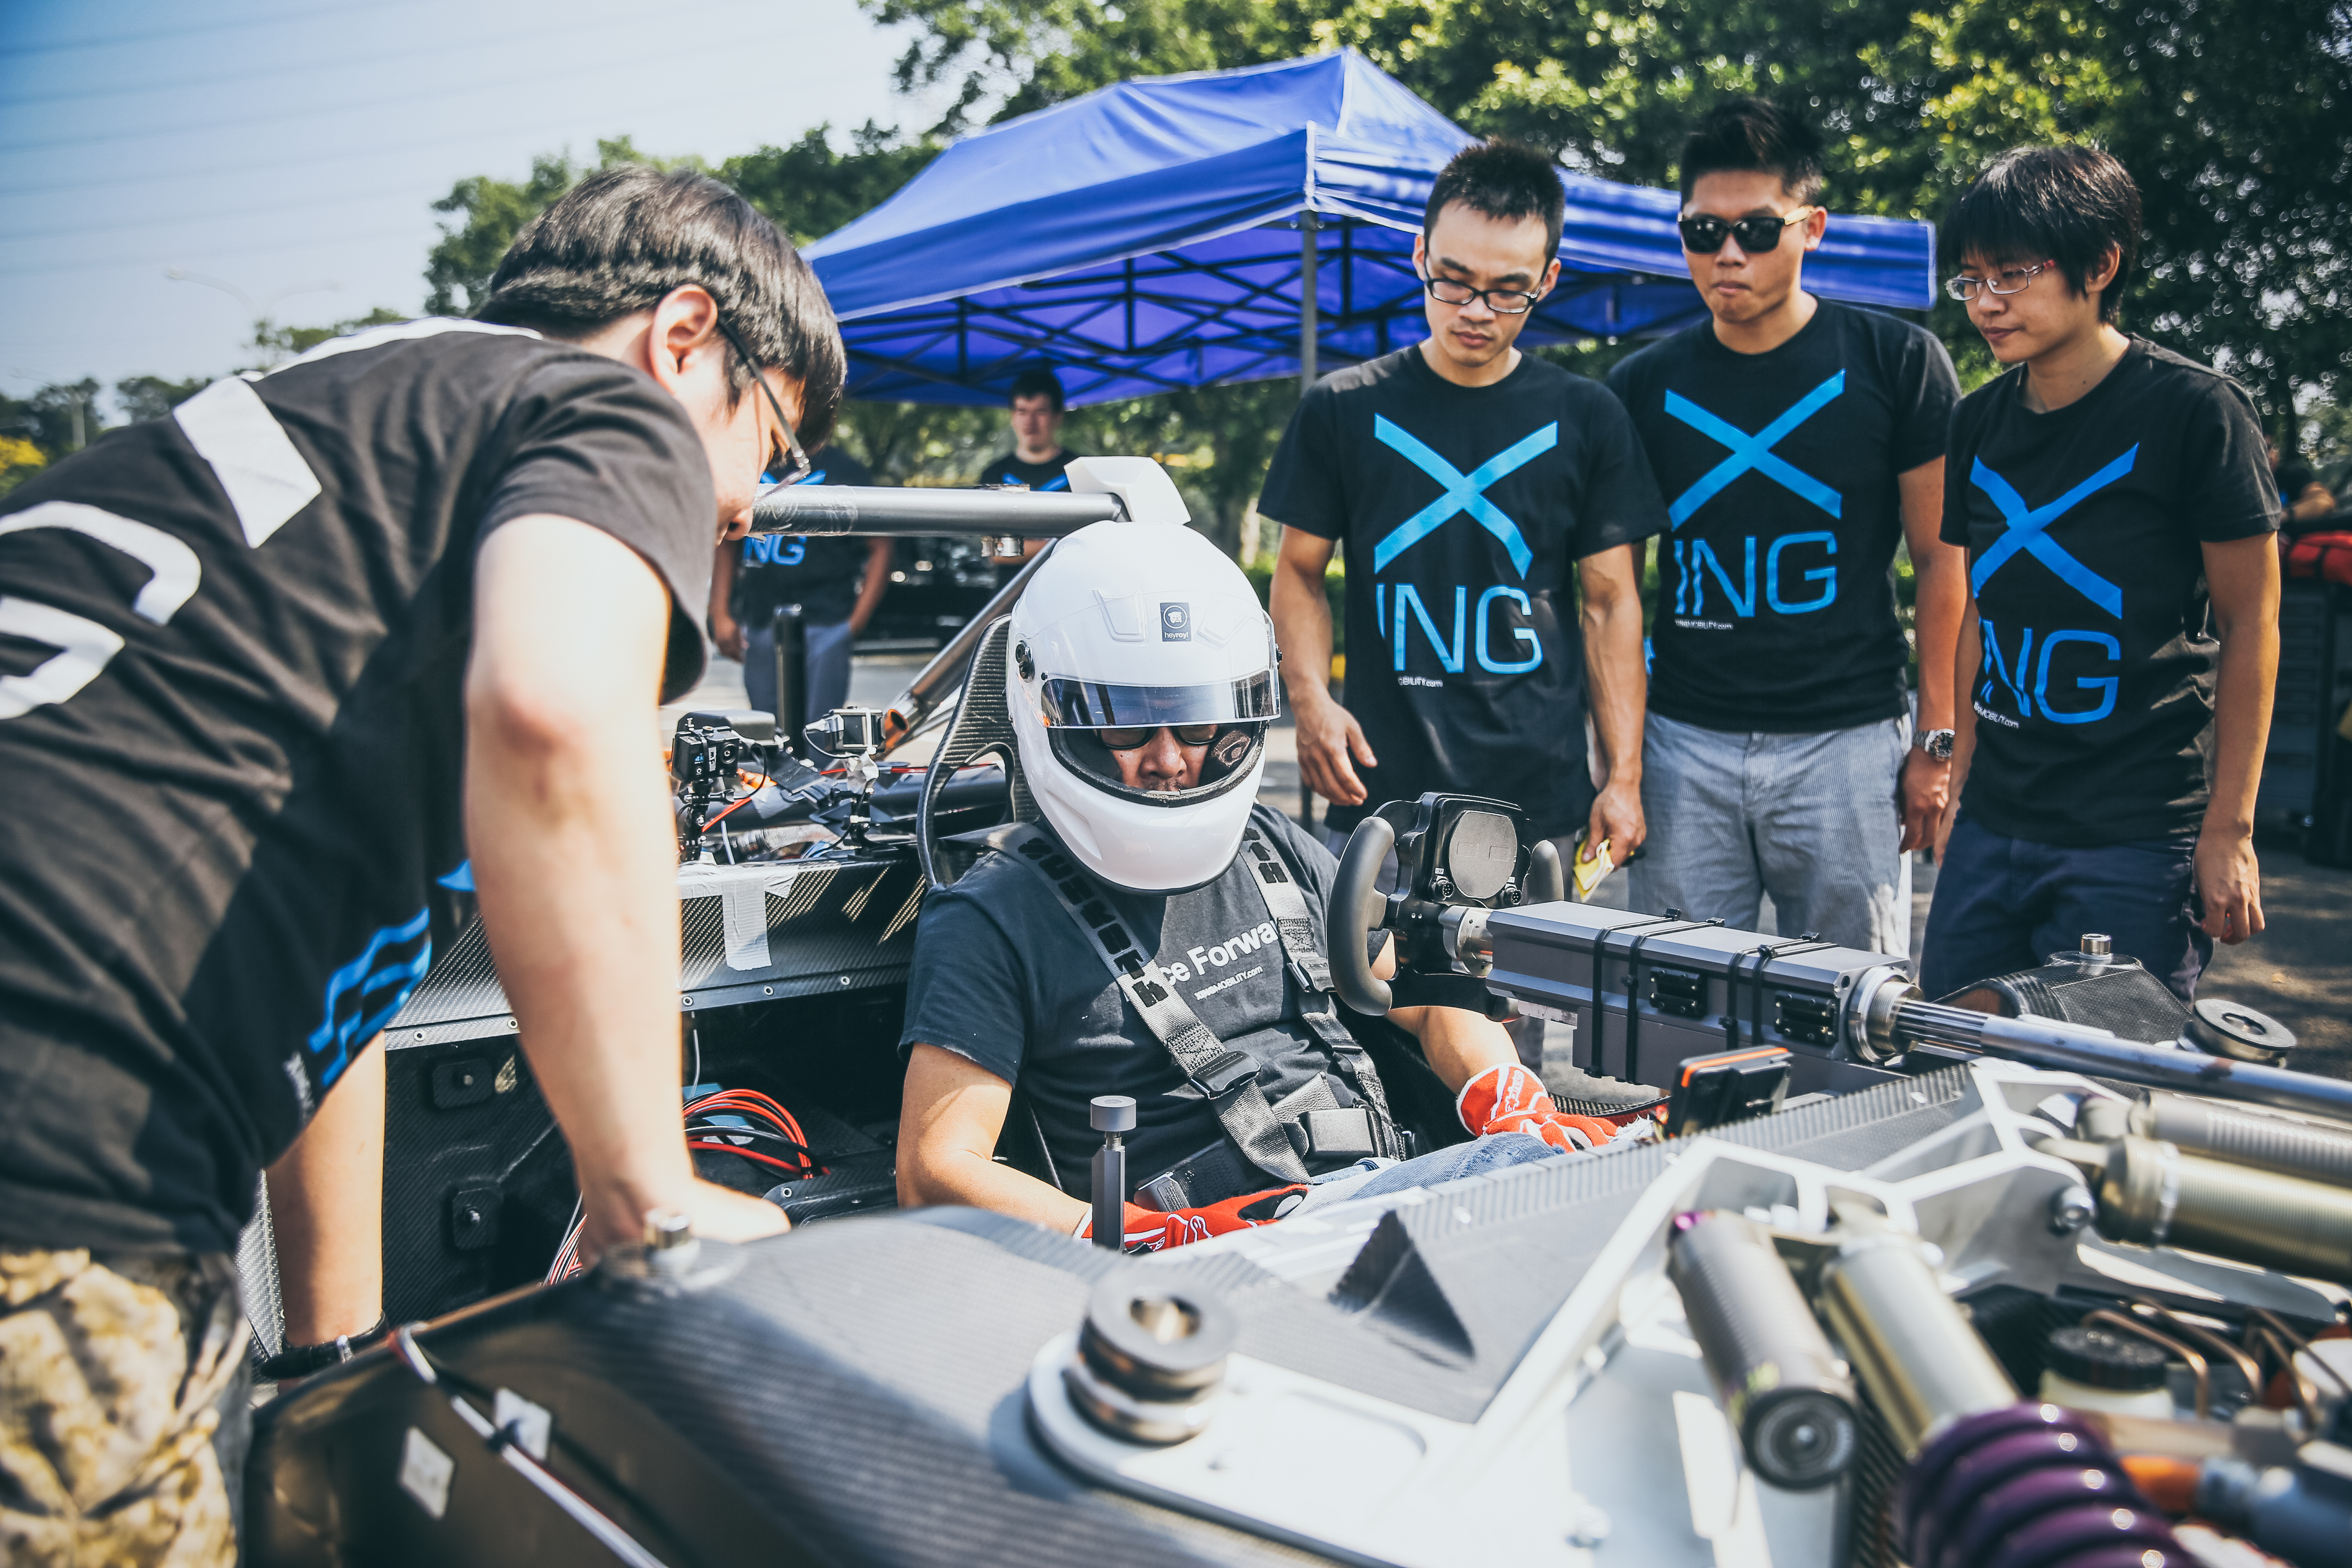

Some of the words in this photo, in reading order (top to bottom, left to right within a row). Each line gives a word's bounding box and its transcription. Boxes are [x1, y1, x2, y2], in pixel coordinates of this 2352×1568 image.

[1674, 531, 1838, 617] ING
[1164, 631, 1189, 639] heyroy!
[1978, 616, 2121, 724] NG
[1186, 920, 1279, 976] Forwa
[1194, 965, 1263, 1000] XINGMOBILITY.com
